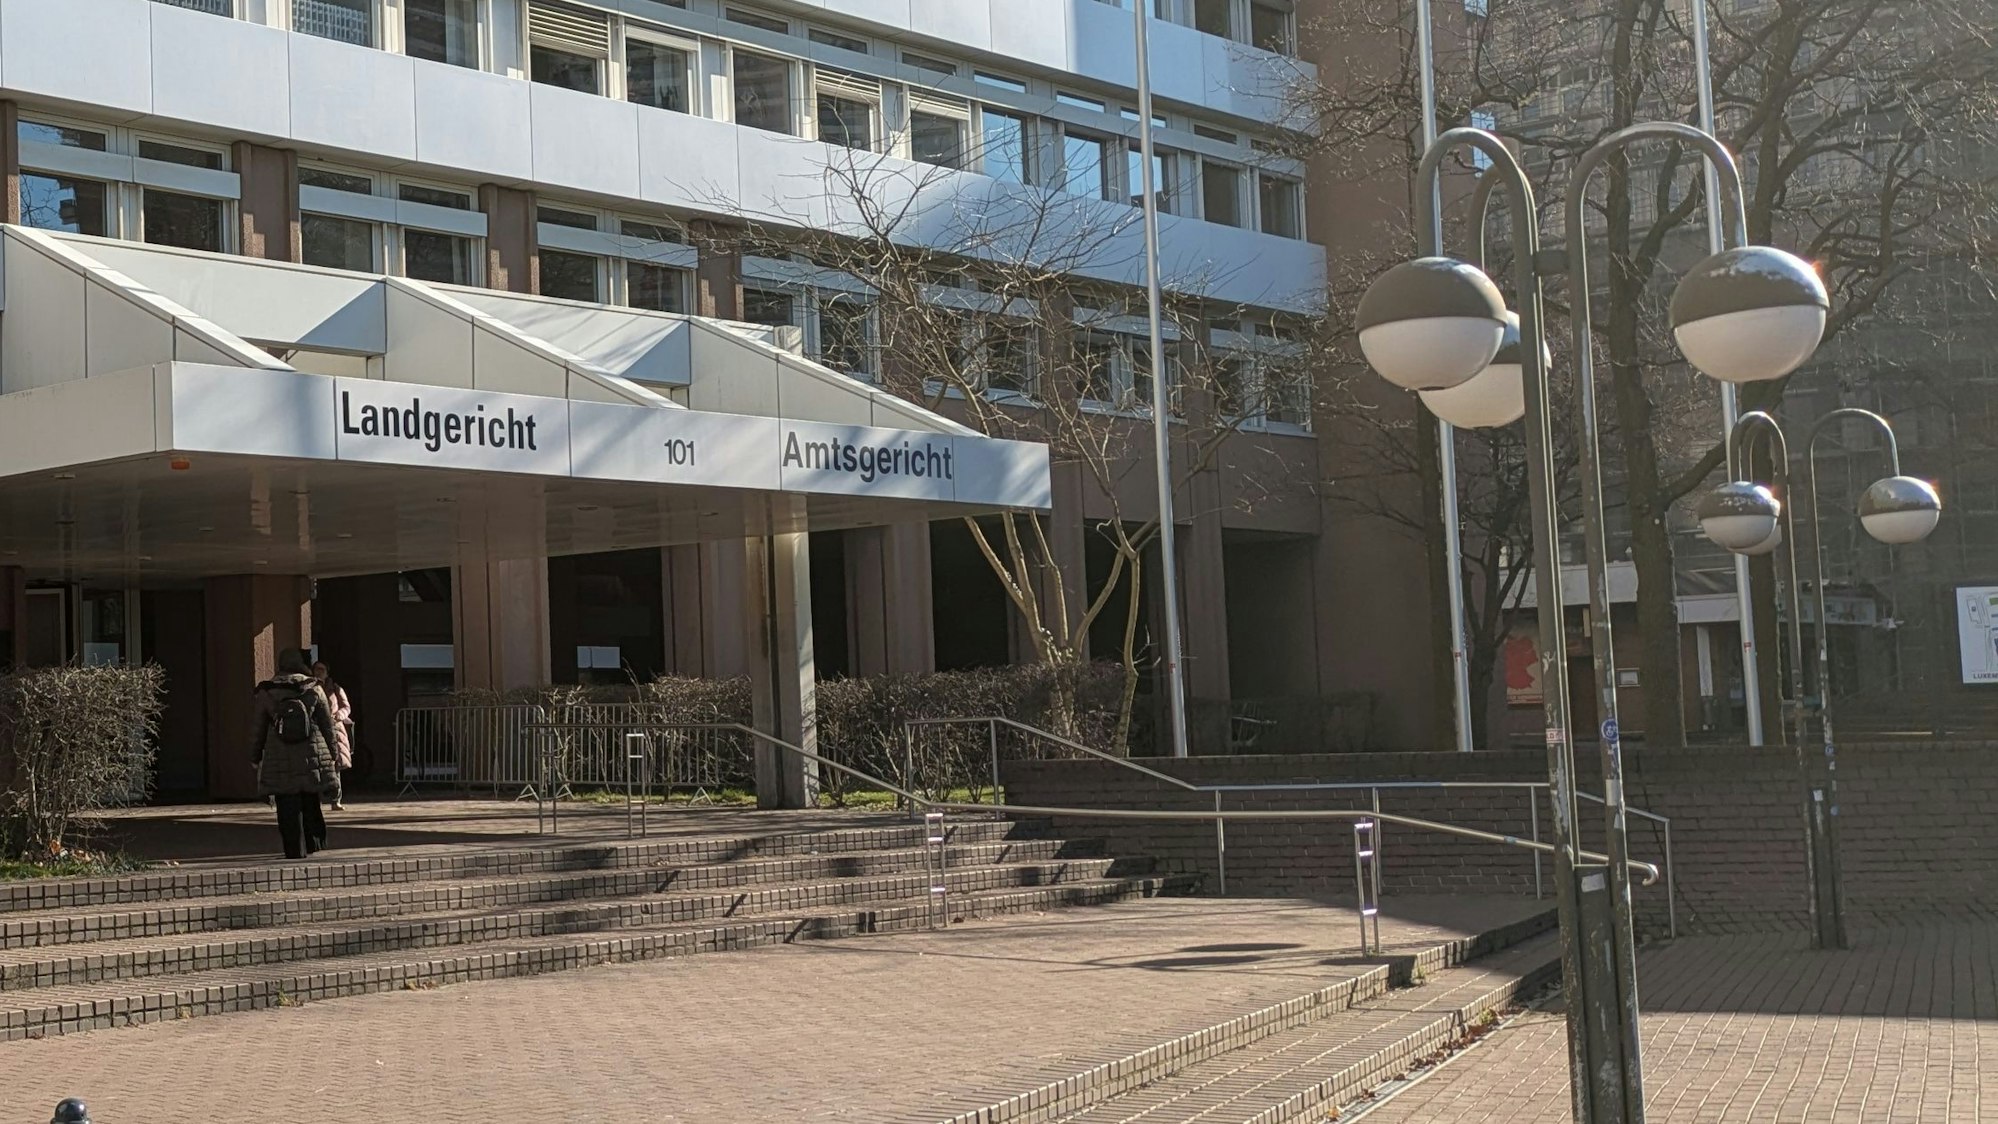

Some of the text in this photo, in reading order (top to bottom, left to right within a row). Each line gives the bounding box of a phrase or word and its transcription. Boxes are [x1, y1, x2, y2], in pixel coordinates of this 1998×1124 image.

[343, 391, 537, 453] Landgericht
[664, 439, 696, 466] 101
[783, 431, 953, 482] Amtsgericht
